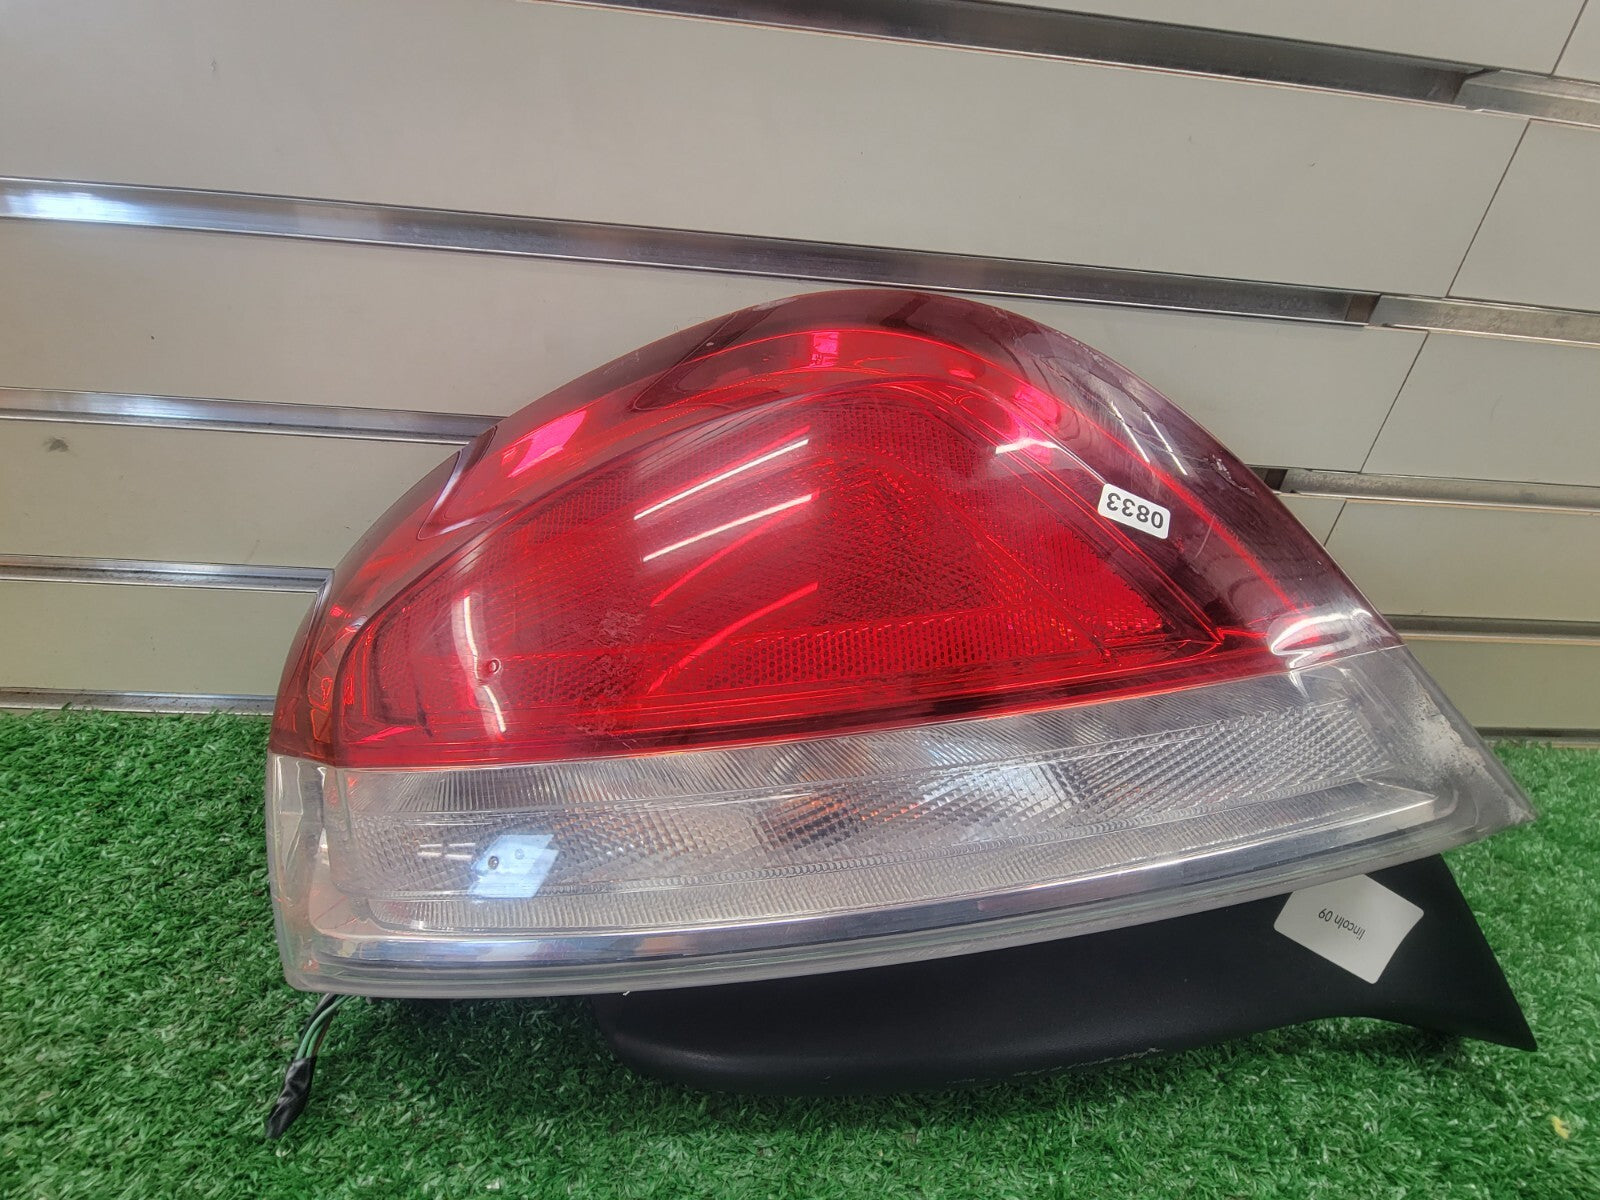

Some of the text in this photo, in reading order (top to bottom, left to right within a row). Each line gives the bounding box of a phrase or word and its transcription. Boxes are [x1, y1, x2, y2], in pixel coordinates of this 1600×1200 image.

[1106, 492, 1164, 529] 0833
[1318, 908, 1366, 941] lincoln 09
